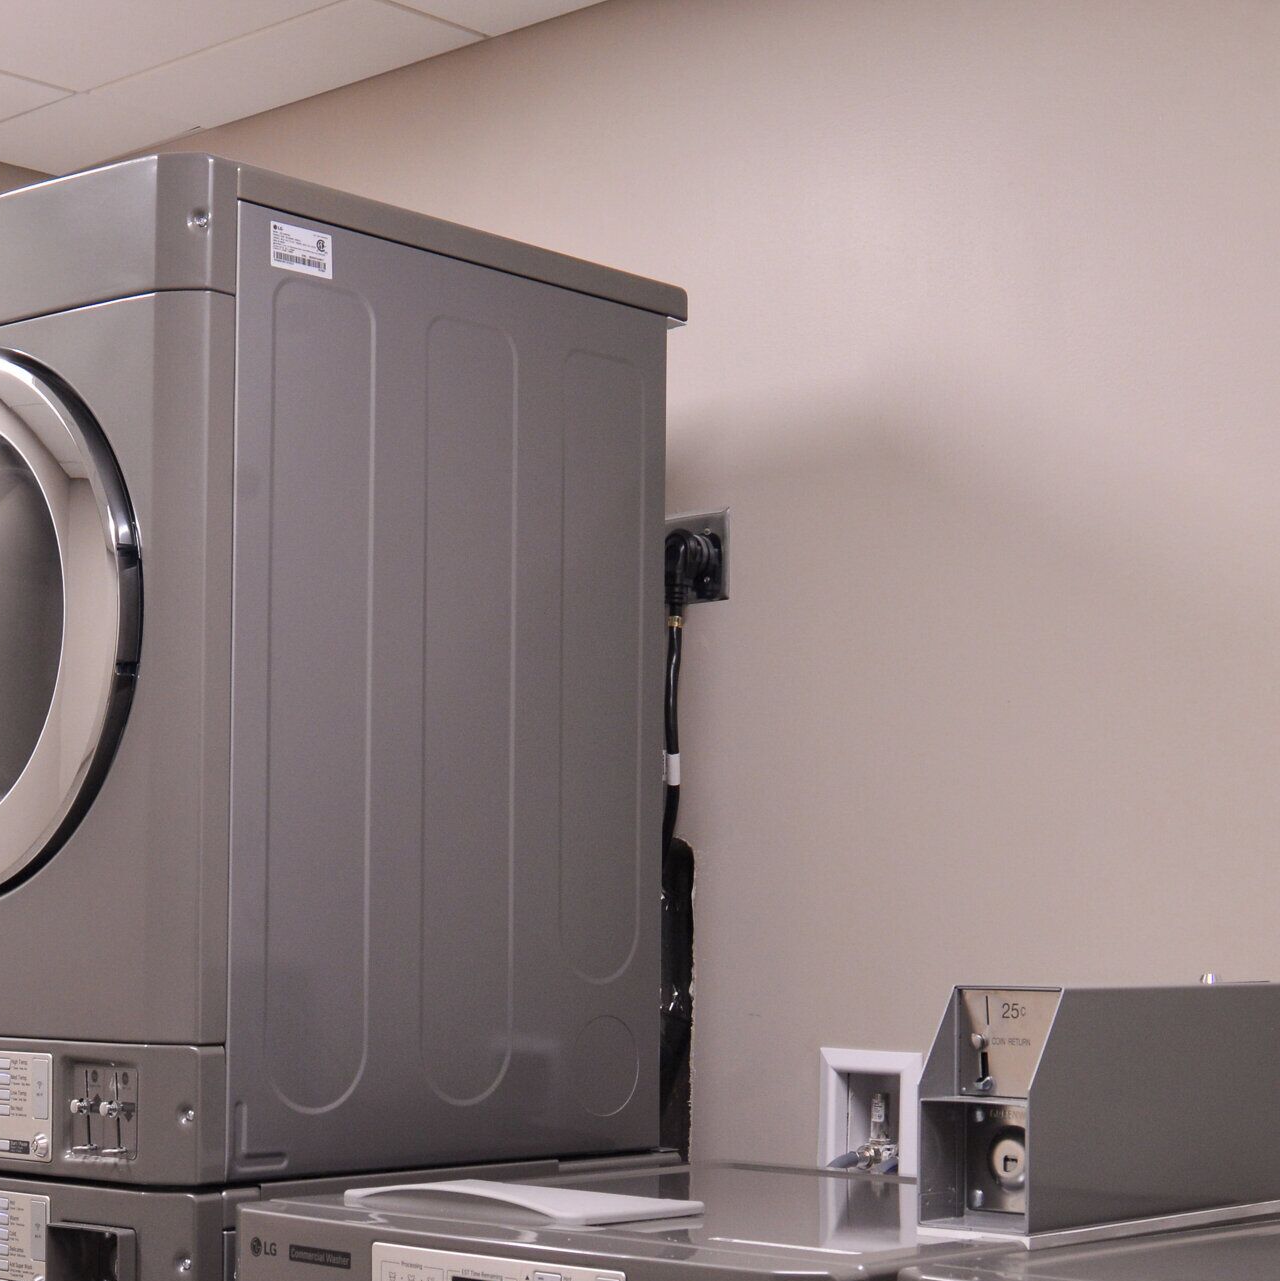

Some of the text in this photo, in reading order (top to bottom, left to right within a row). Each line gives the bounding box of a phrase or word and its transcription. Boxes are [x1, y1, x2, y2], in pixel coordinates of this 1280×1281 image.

[991, 1038, 1031, 1047] COIN RETURN
[264, 1241, 277, 1256] LG
[291, 1247, 350, 1266] Commercial Washer
[401, 1260, 422, 1270] Processing
[481, 1271, 503, 1281] Remaining
